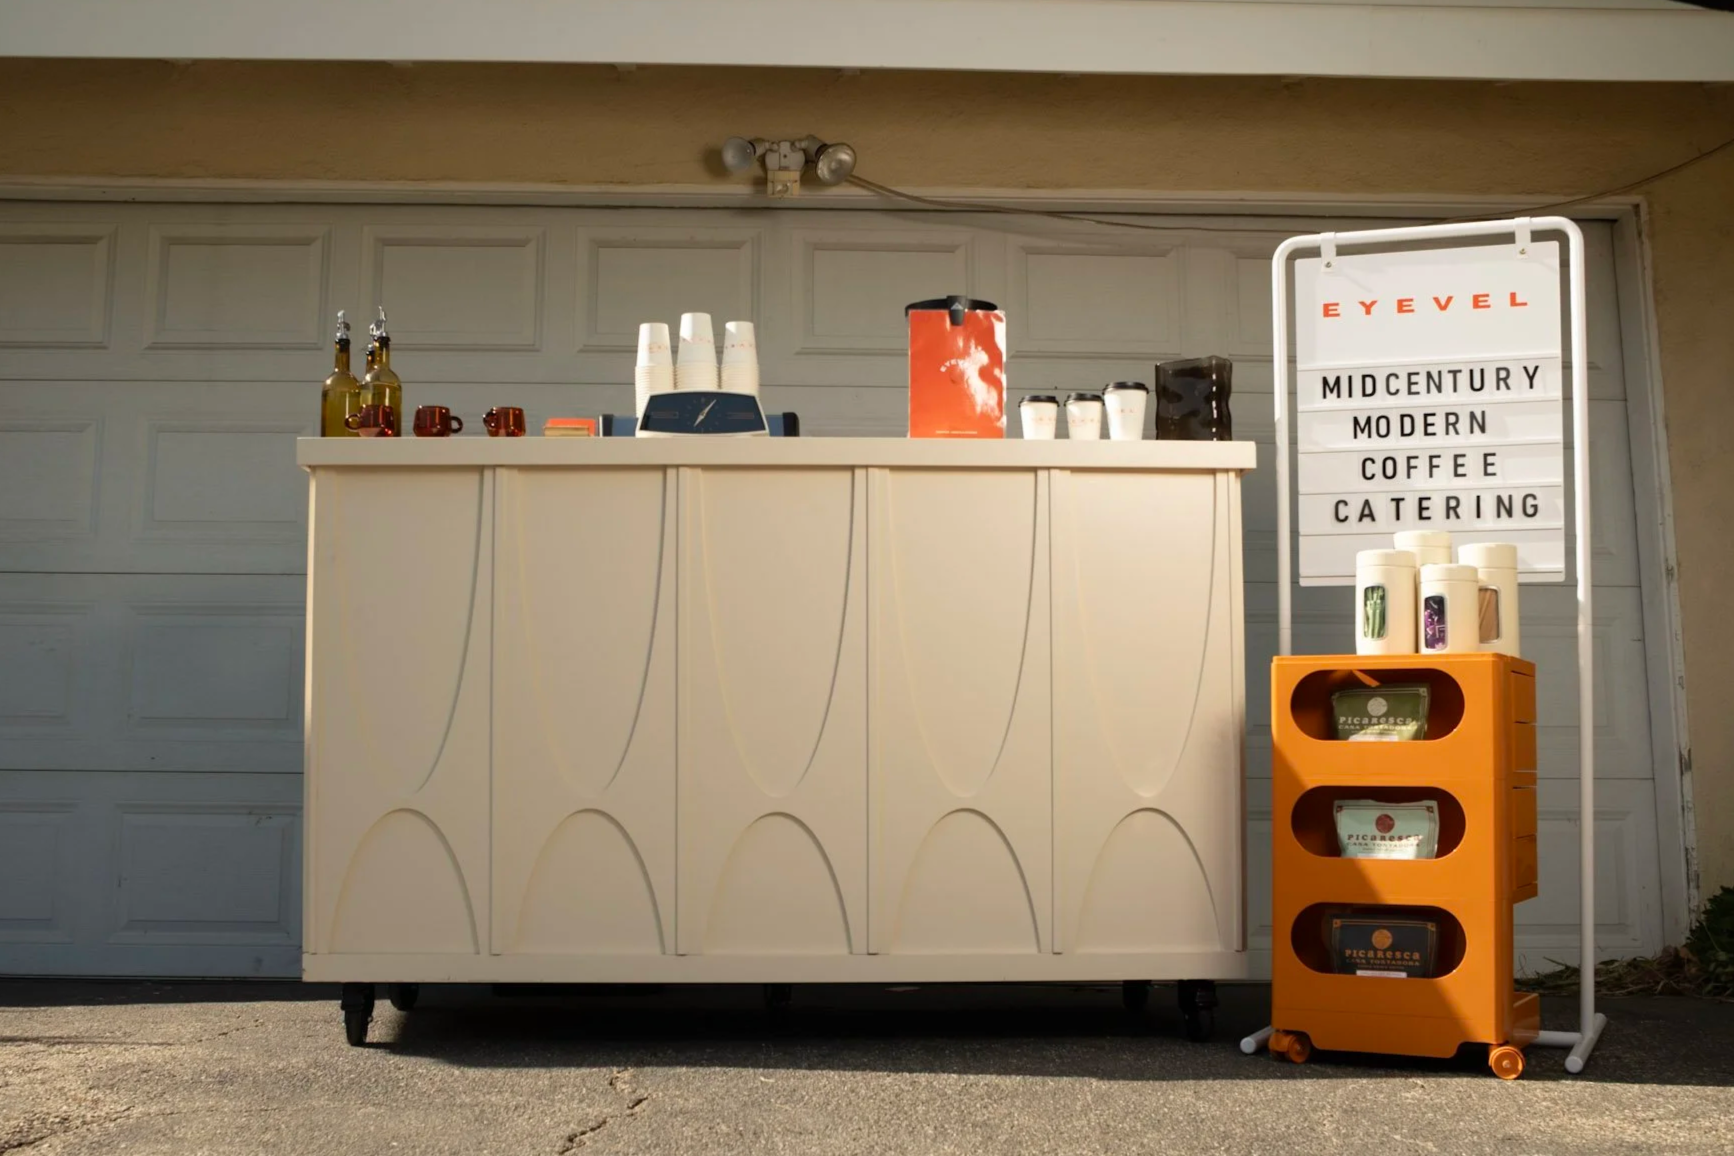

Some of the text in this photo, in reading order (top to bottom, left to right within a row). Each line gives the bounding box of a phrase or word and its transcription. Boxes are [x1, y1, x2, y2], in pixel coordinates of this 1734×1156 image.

[1322, 292, 1528, 318] EYEVEL
[1321, 365, 1540, 400] MIDCENTURY
[1352, 410, 1487, 440] MODERN
[1361, 452, 1498, 481] COFFEE
[1333, 493, 1539, 523] CATERING
